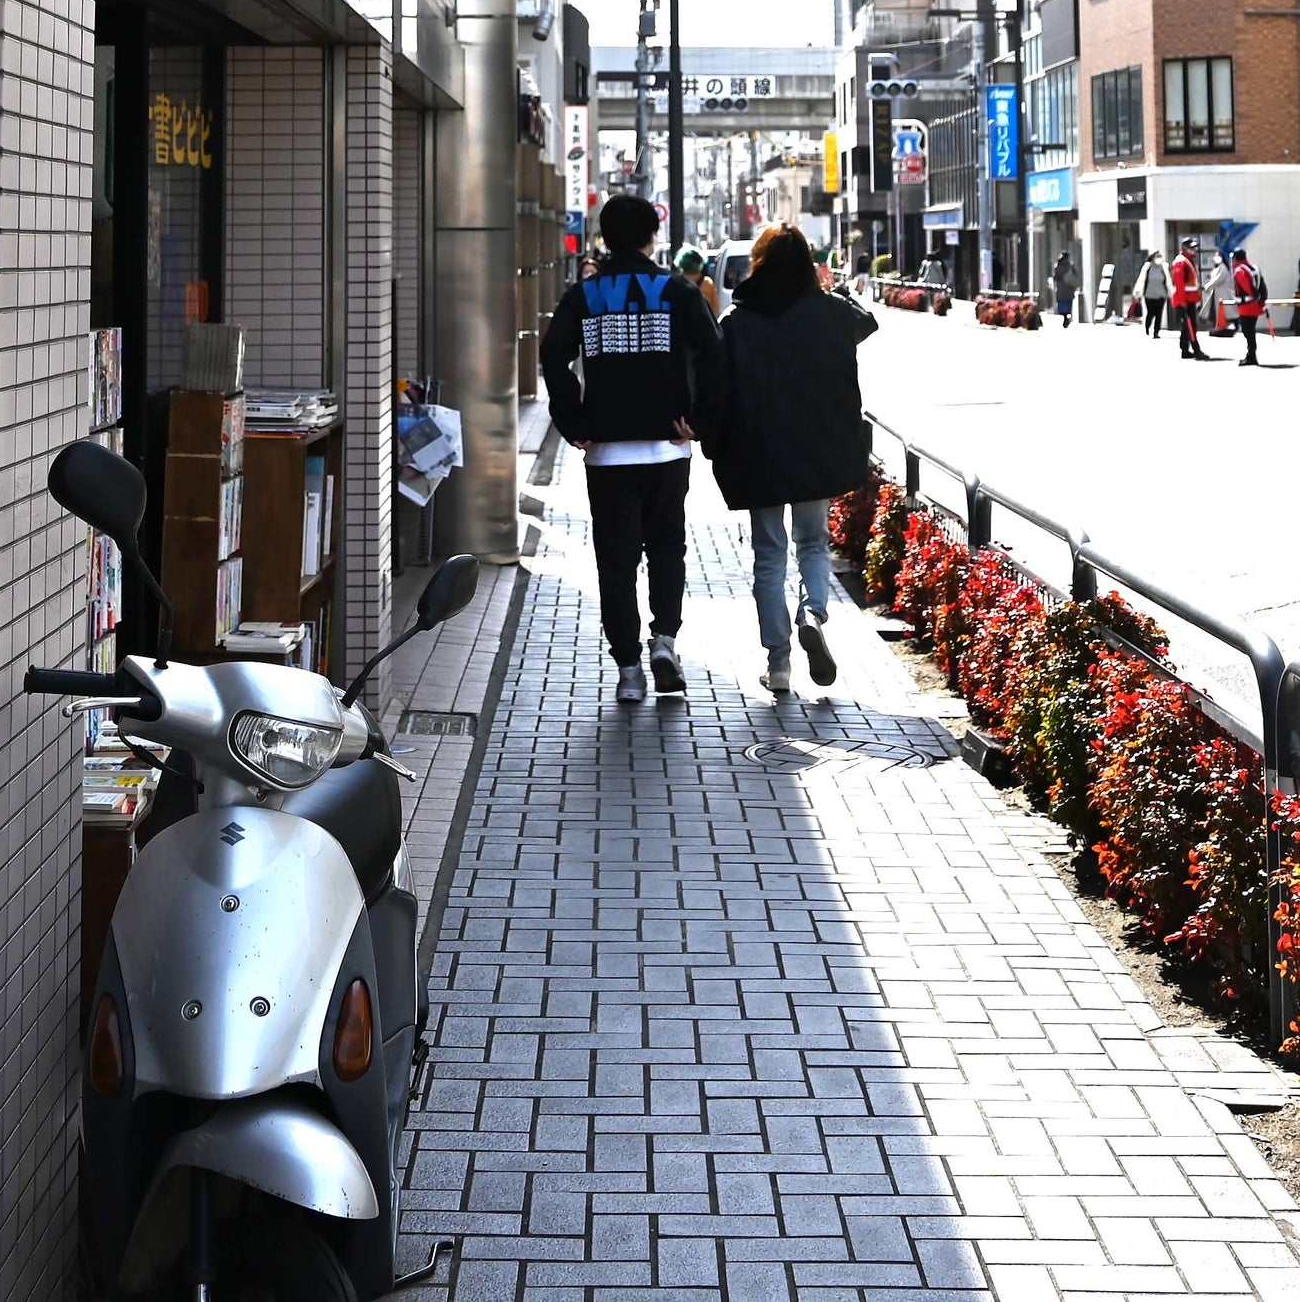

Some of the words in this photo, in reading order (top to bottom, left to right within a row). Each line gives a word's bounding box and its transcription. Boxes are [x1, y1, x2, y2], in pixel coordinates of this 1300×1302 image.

[681, 77, 771, 96] 井の頭線
[149, 93, 213, 168] 書ビビビ
[582, 273, 671, 315] W.Y.
